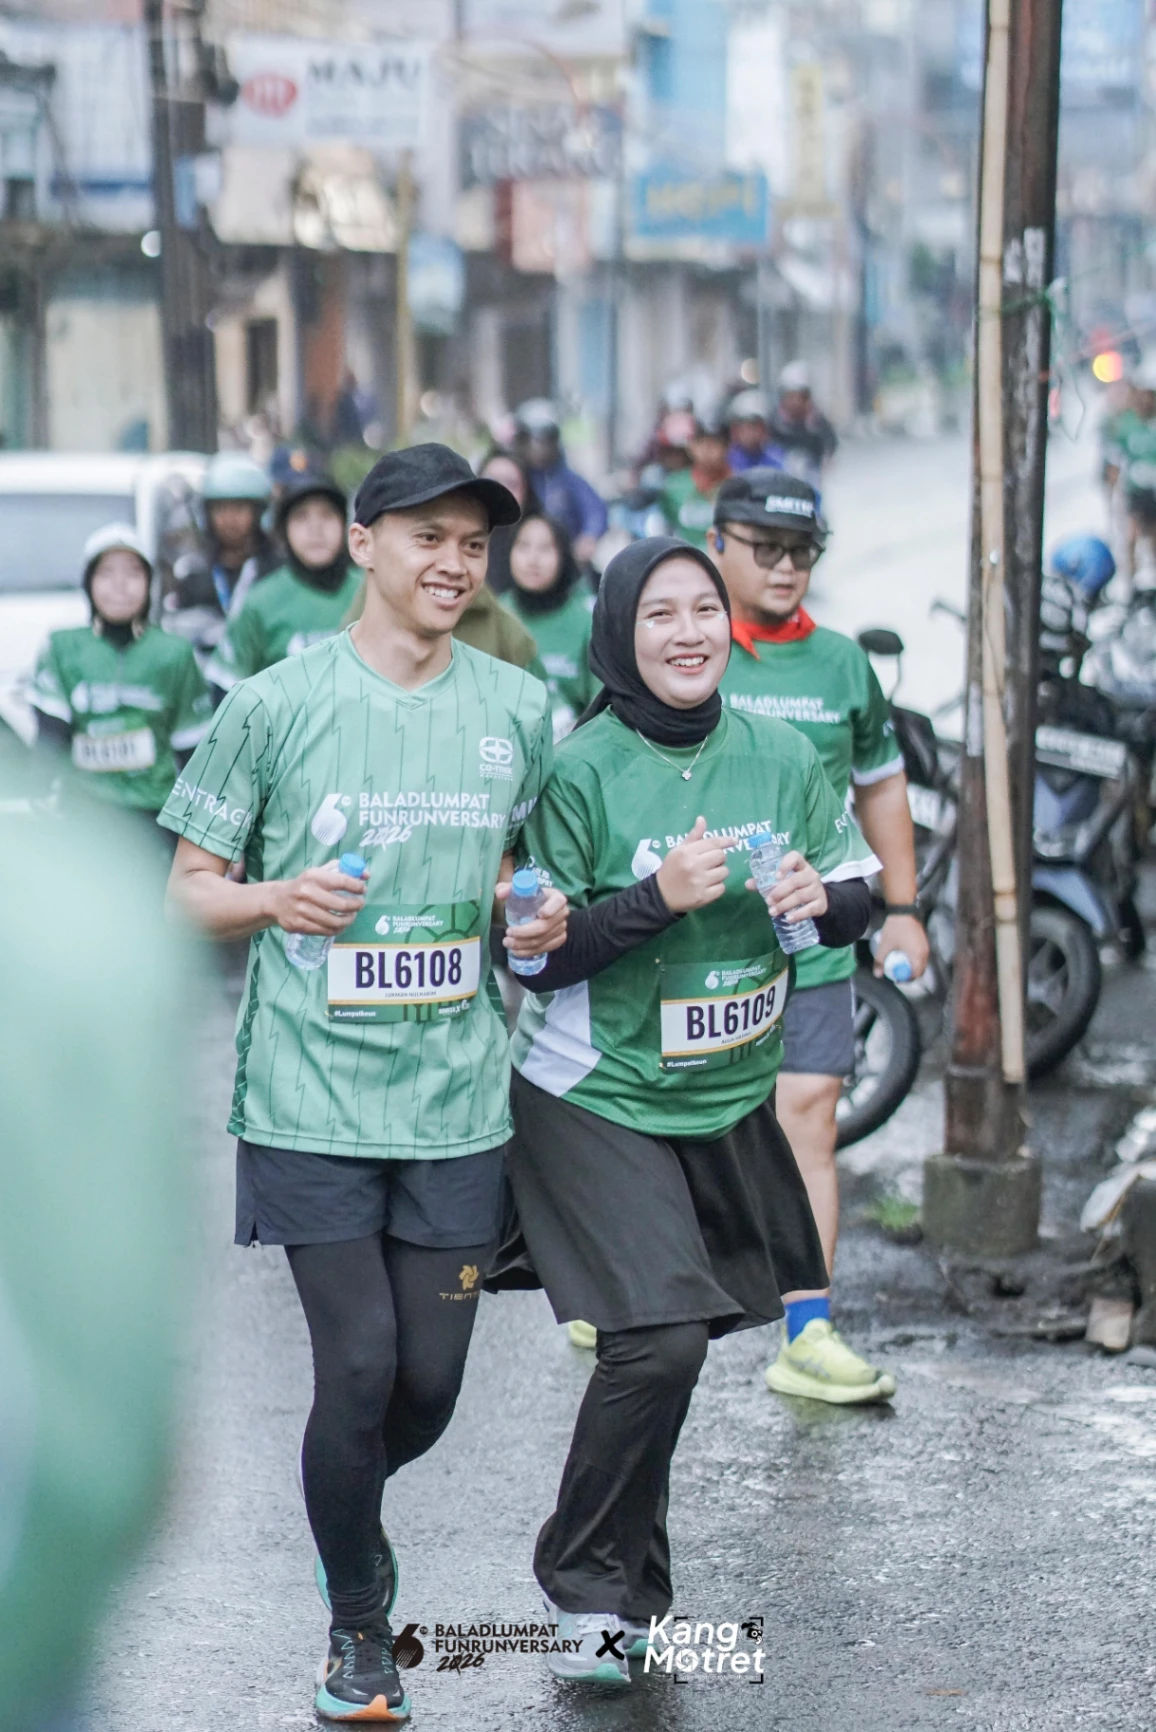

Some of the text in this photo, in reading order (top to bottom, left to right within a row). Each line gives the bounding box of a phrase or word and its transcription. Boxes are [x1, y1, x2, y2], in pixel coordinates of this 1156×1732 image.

[359, 792, 490, 810] BALADLUMPAT
[359, 810, 506, 829] FUNRUNVERSARY
[355, 947, 462, 989] BL6108
[686, 985, 776, 1041] BL6109
